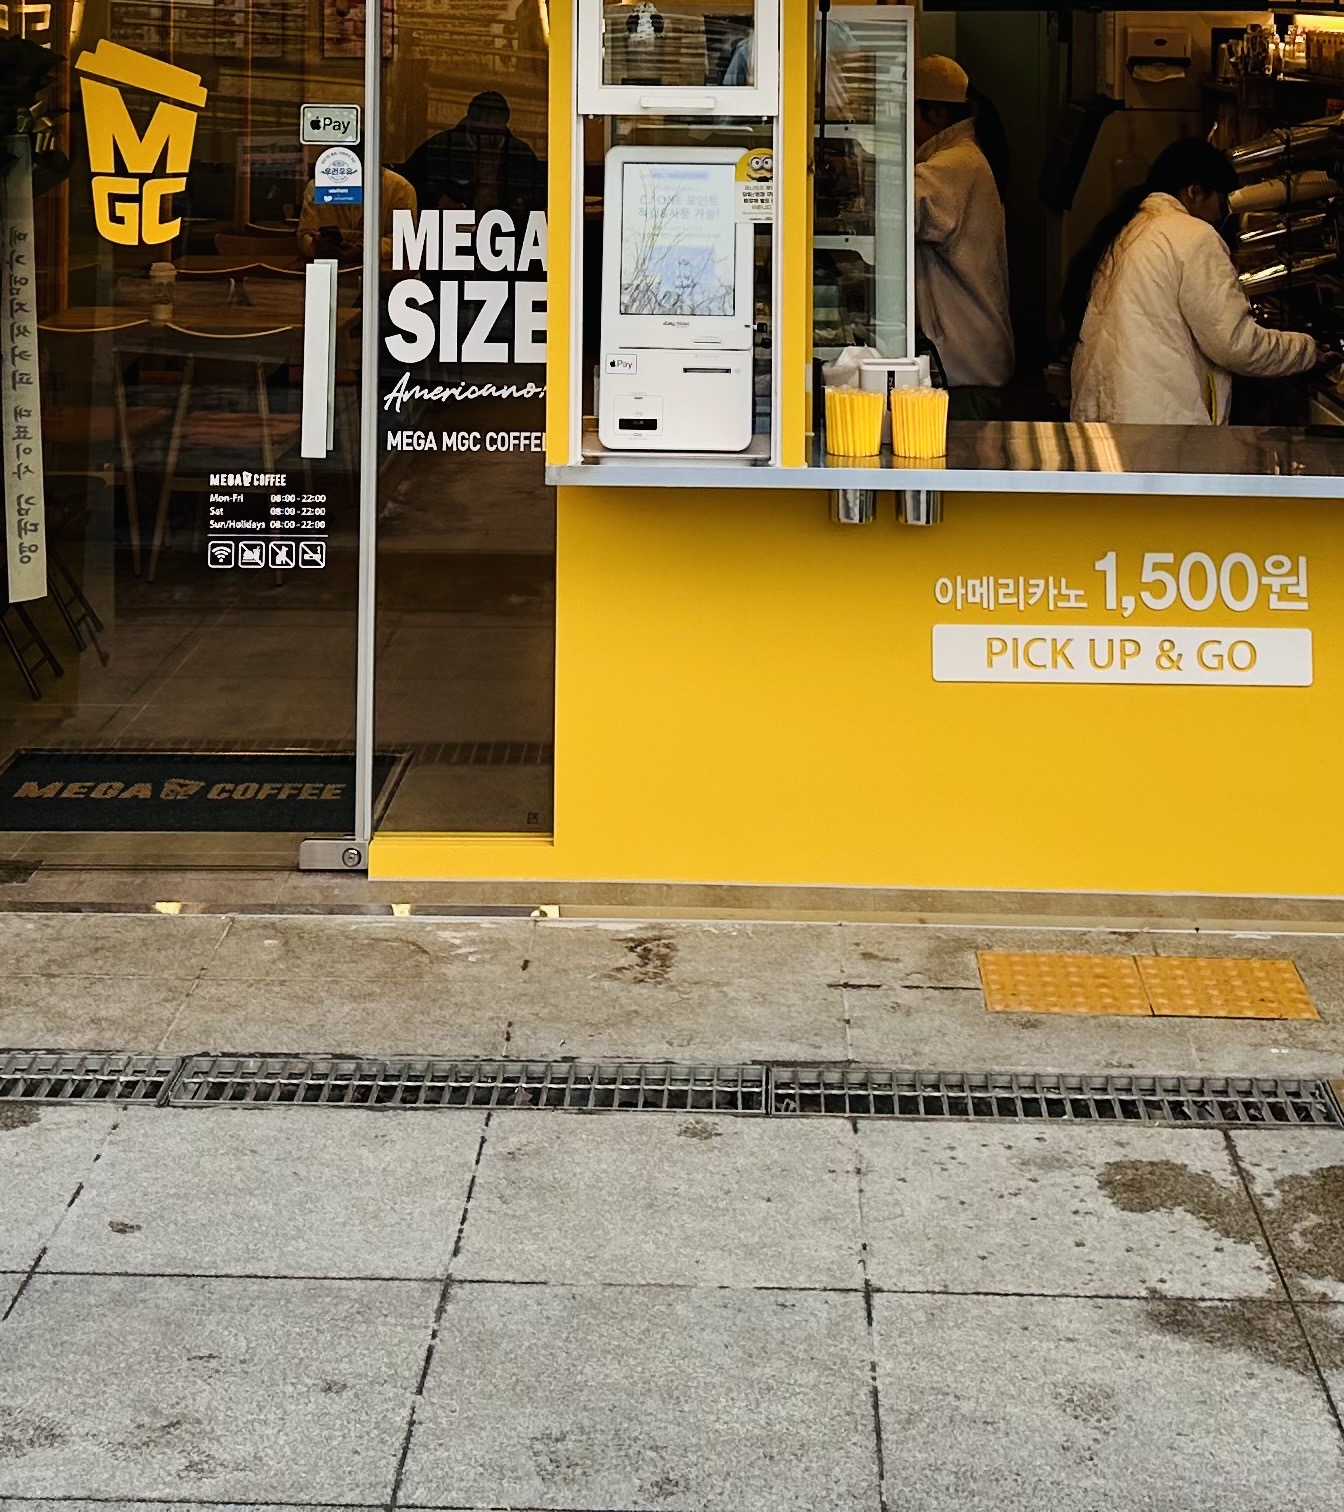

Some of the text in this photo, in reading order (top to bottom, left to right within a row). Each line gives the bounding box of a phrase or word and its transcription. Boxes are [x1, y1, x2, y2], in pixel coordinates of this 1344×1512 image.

[322, 116, 351, 135] Pay
[391, 209, 548, 271] MEGA
[384, 279, 547, 364] SIZE
[383, 371, 546, 413] Americano
[386, 430, 438, 452] MEGA
[442, 431, 482, 452] MGC
[209, 473, 287, 487] MEGA COFFEE
[934, 550, 1310, 619] 아메리카노 1,500원
[984, 637, 1258, 674] PICK UP & GO
[12, 780, 346, 803] MEGA COFFEE
